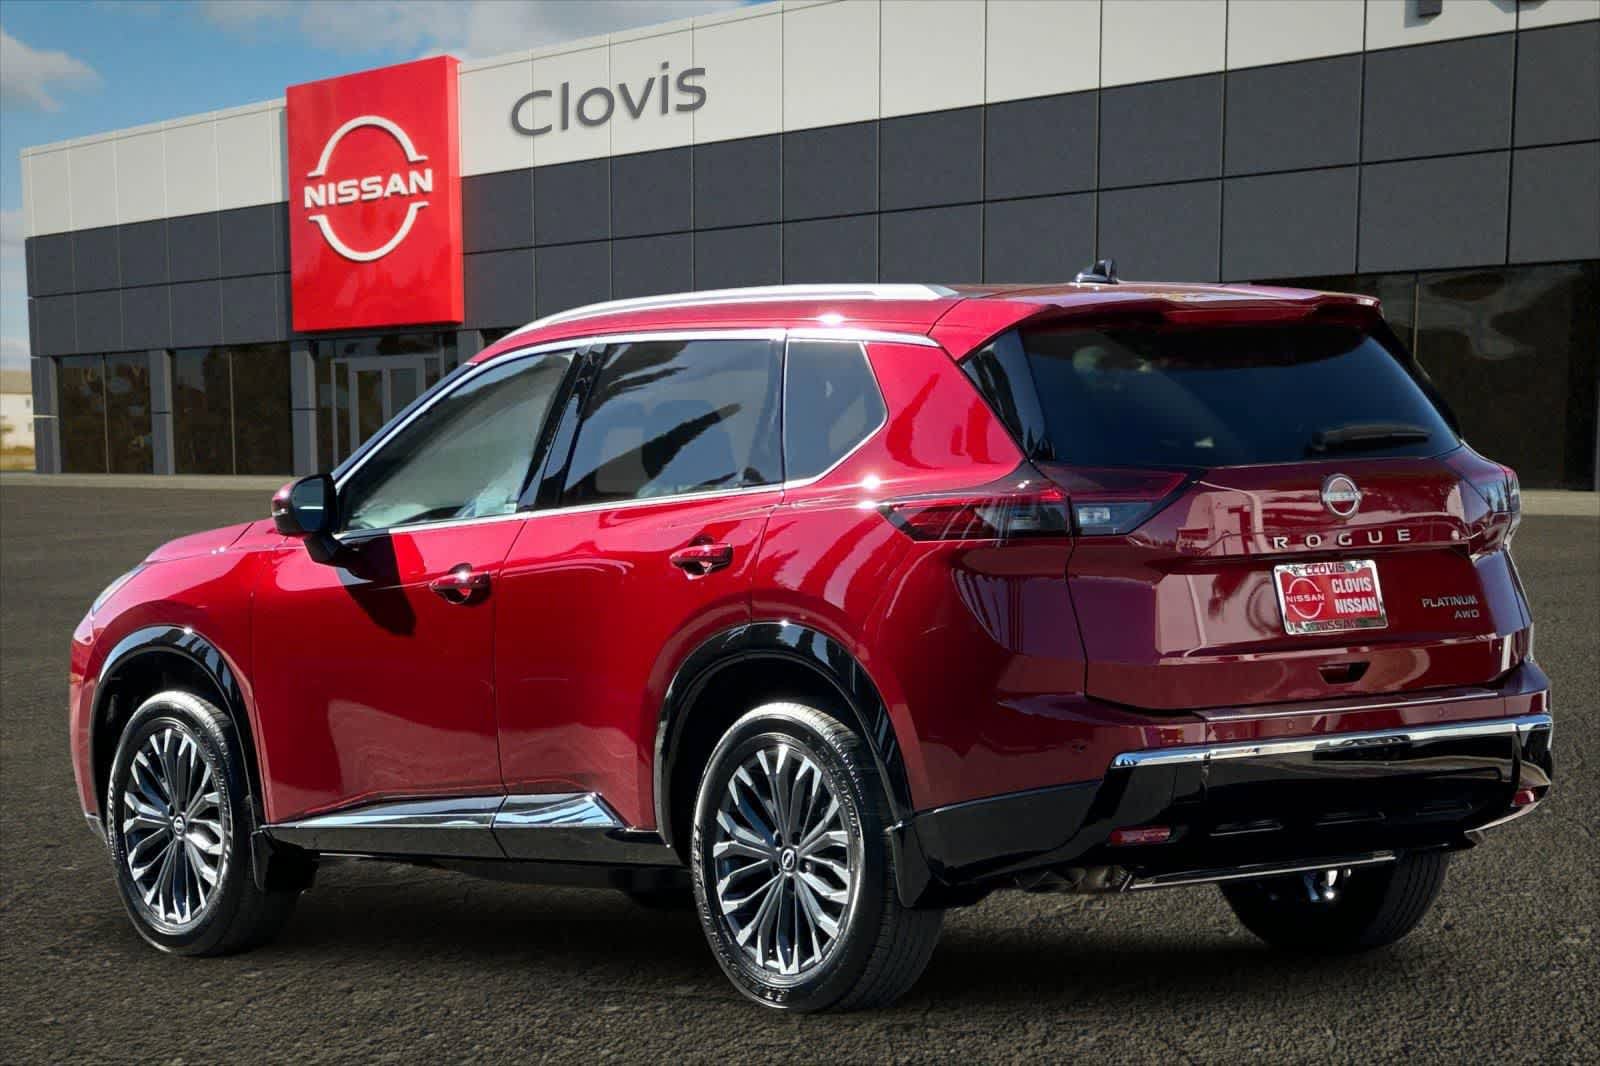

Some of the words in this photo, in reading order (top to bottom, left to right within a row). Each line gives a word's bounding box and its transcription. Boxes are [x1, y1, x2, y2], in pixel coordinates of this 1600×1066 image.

[511, 61, 707, 137] Clovis
[304, 168, 433, 209] NISSAN
[1272, 528, 1412, 549] ROGUE
[1331, 576, 1372, 594] CLOVIS
[1286, 592, 1325, 604] NISSAN
[1335, 596, 1378, 614] NISSAN
[1421, 594, 1478, 609] PLATINUM
[1454, 609, 1480, 620] AWD
